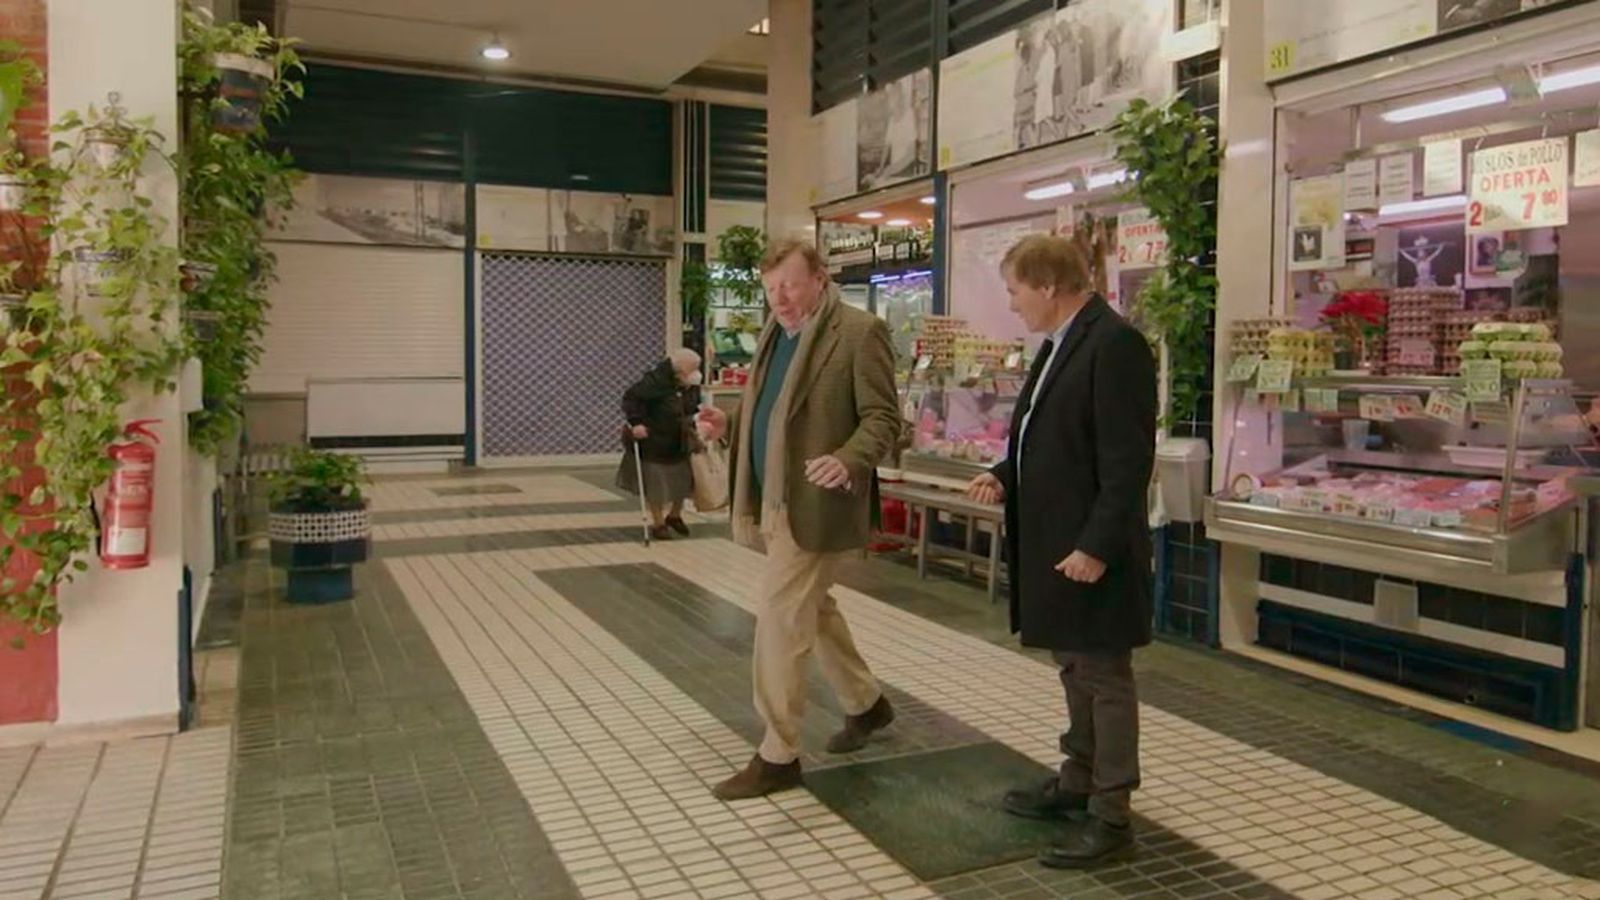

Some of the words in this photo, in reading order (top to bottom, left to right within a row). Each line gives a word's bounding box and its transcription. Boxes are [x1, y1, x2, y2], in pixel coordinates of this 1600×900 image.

[1271, 46, 1289, 69] 31
[1480, 166, 1551, 193] OFERTA
[1469, 201, 1482, 228] 2
[1521, 192, 1536, 221] 7
